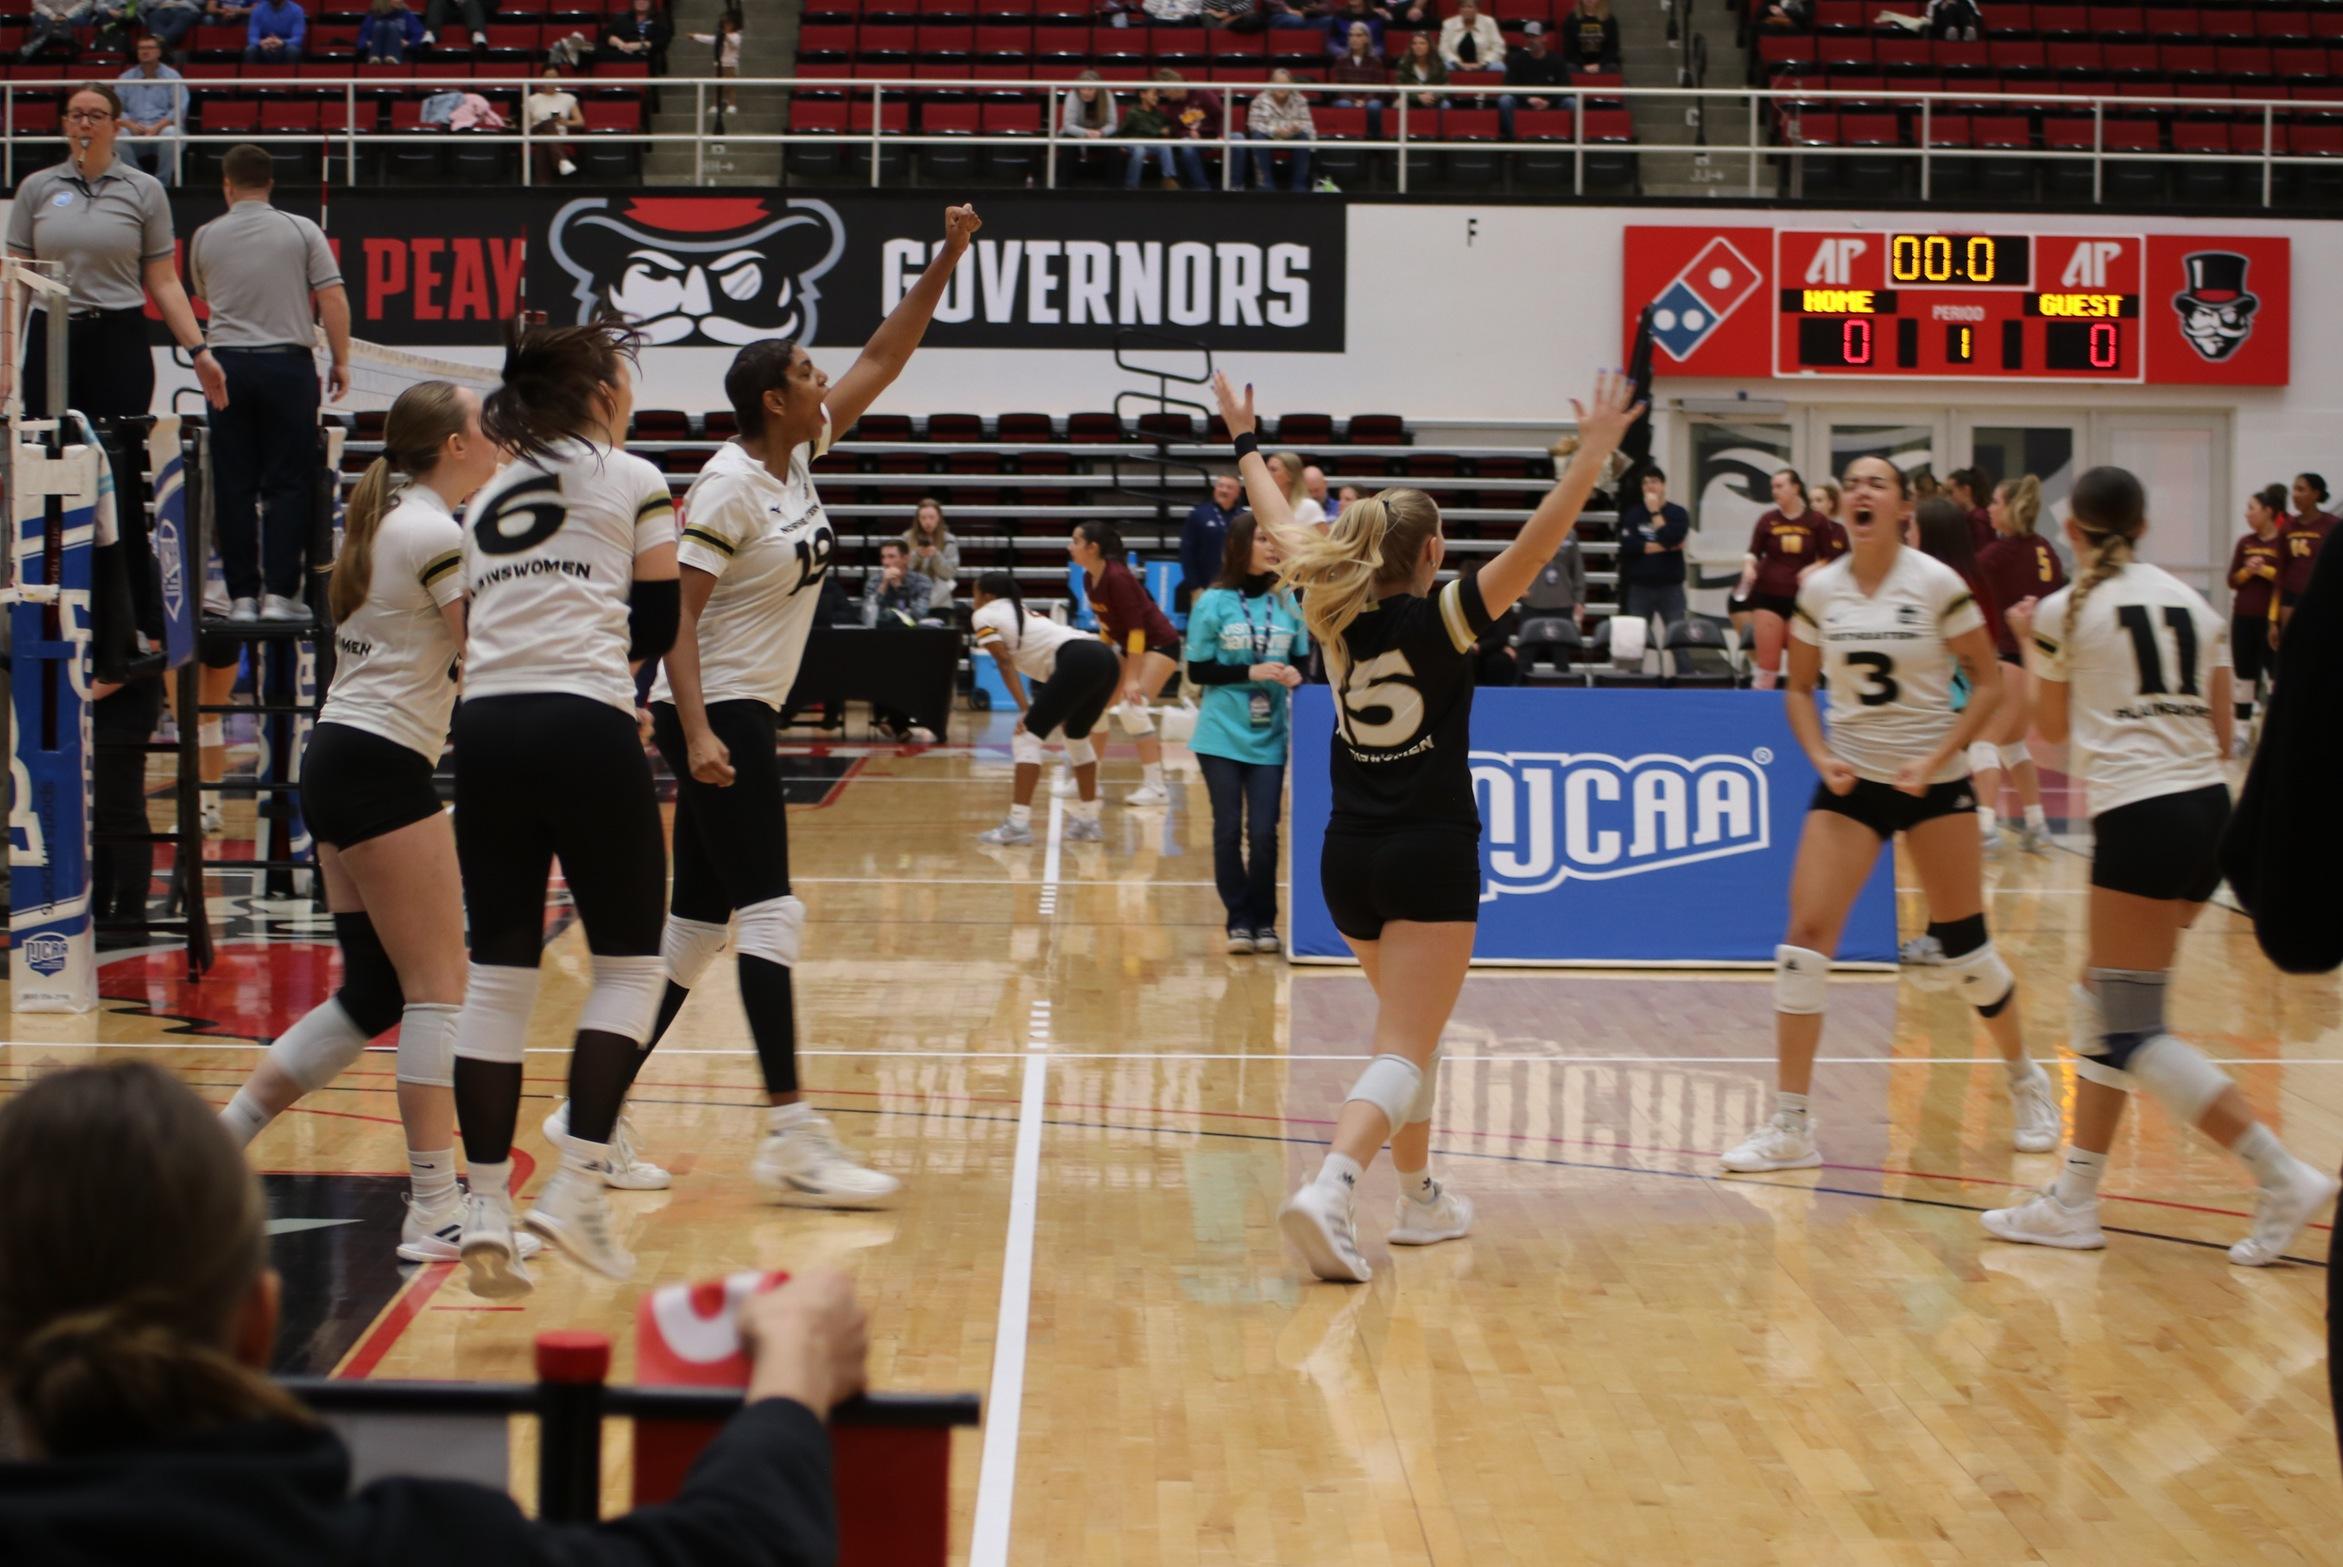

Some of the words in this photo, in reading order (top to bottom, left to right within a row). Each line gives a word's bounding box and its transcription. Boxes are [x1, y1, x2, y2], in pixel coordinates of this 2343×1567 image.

[363, 238, 525, 321] PEAY
[1892, 235, 1995, 282] 00.0
[882, 237, 1310, 327] GOVERNORS
[1802, 289, 1876, 314] HOME
[1931, 304, 1986, 322] PERIOD
[2038, 293, 2123, 318] GUEST
[1842, 318, 1871, 364] 0
[1960, 327, 1970, 359] 1
[2089, 323, 2117, 368] 0
[474, 474, 568, 557] 6
[2036, 545, 2052, 582] 5
[2117, 605, 2198, 695] 11
[1845, 652, 1899, 706] 3
[1472, 766, 1752, 879] NJCAA
